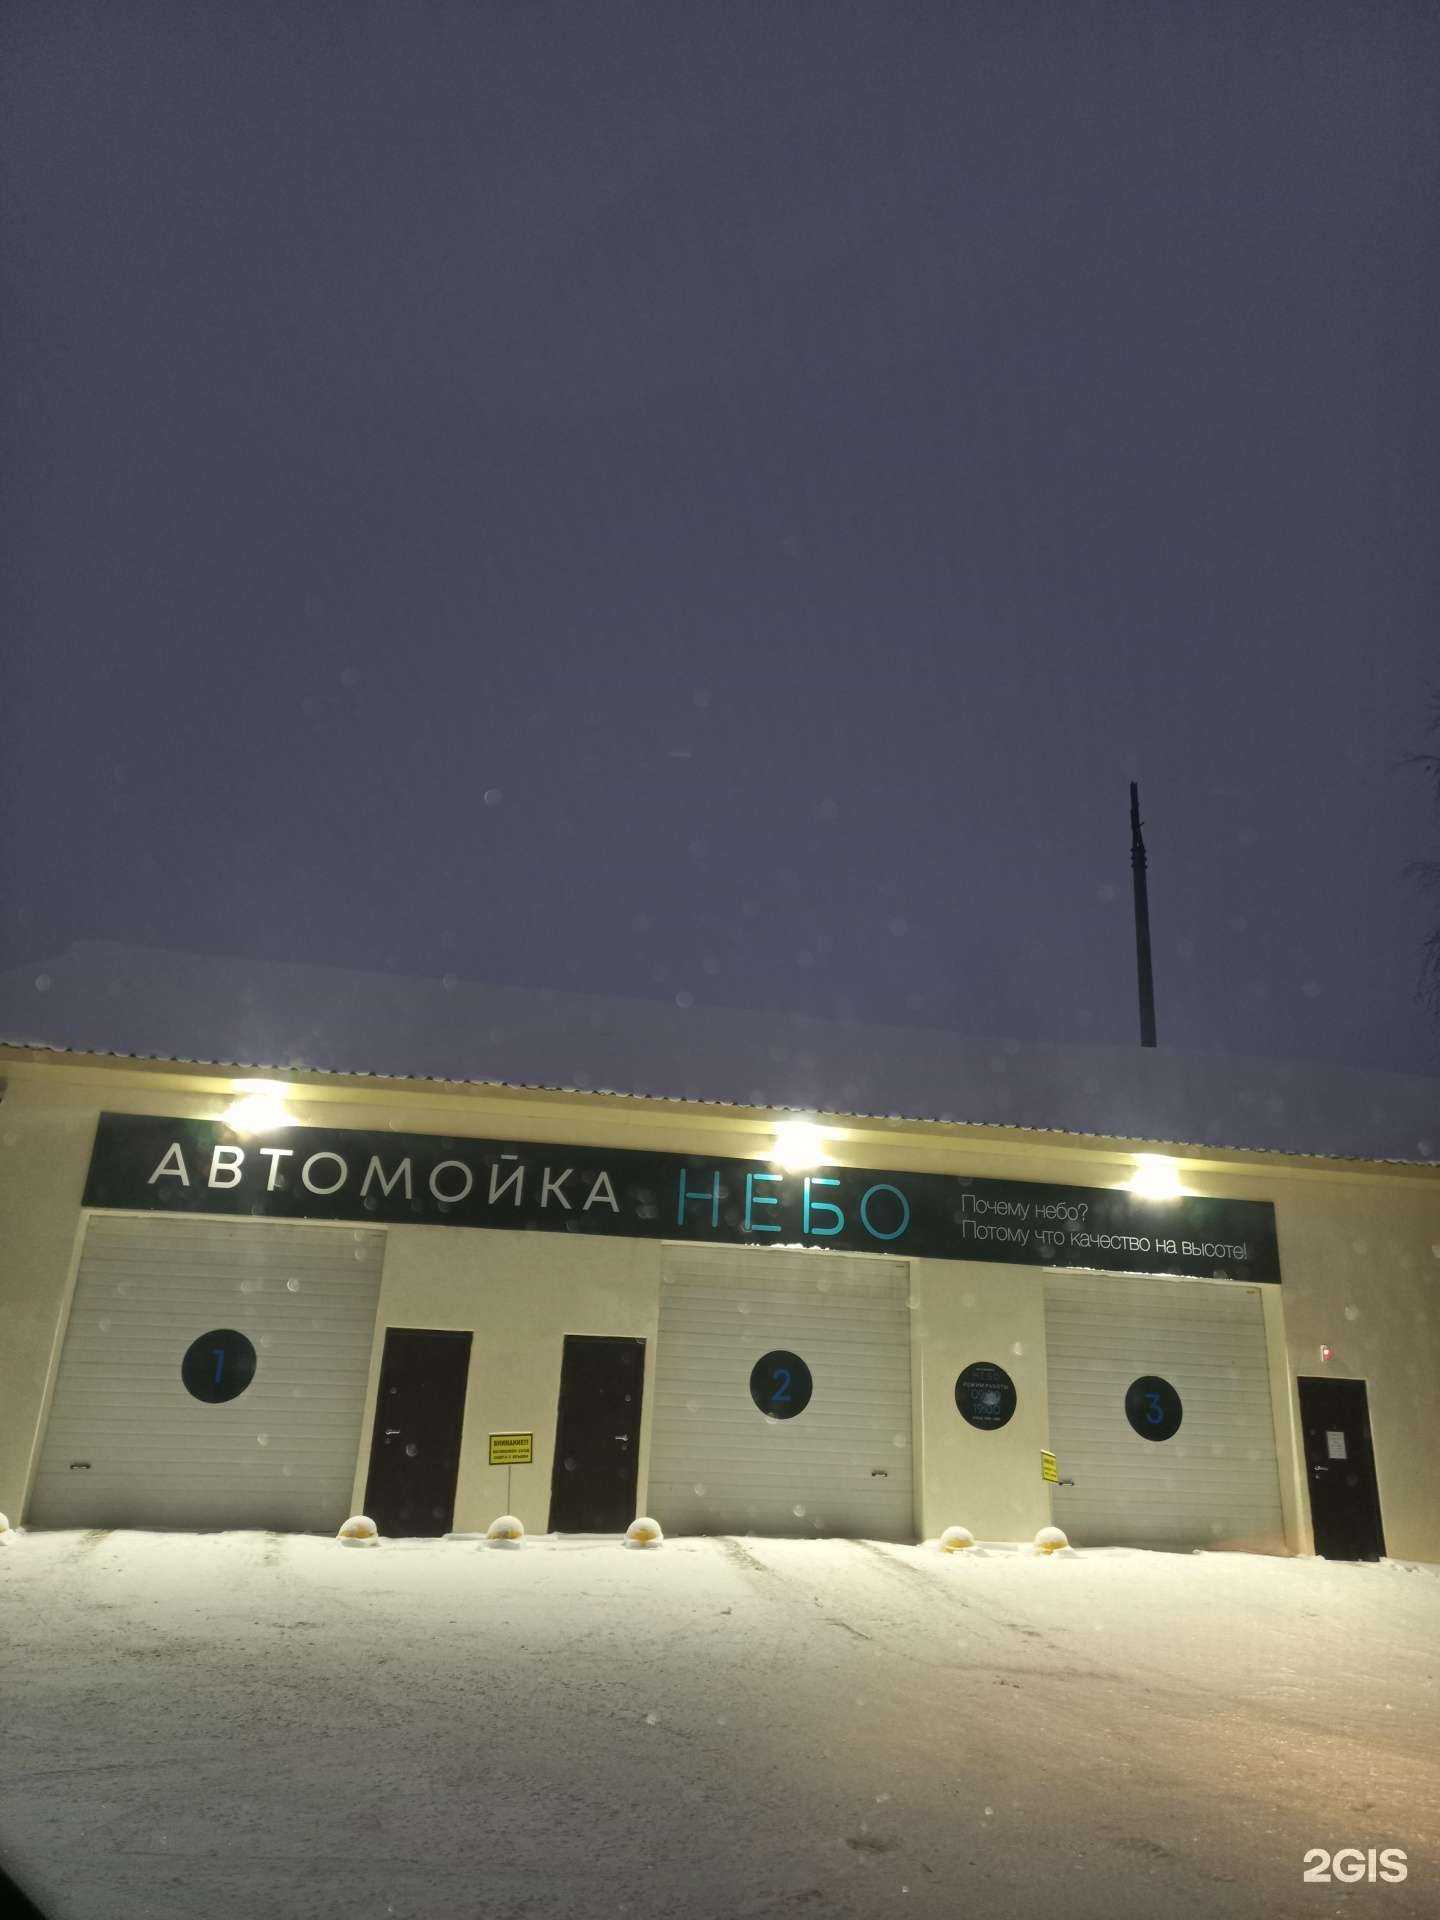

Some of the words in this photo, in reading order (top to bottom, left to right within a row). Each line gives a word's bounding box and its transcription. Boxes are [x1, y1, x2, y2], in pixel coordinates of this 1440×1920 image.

[148, 1142, 621, 1213] АВТОМОЙКА
[676, 1168, 911, 1240] НЕБО
[961, 1194, 1031, 1221] Почему
[1035, 1202, 1089, 1222] небо?
[961, 1219, 1031, 1247] Потому
[1034, 1230, 1066, 1246] что
[1070, 1232, 1151, 1252] качество
[1155, 1238, 1178, 1255] на
[1181, 1240, 1248, 1261] высоте!
[209, 1349, 225, 1385] 1
[771, 1368, 792, 1402] 2
[1145, 1392, 1165, 1424] 3
